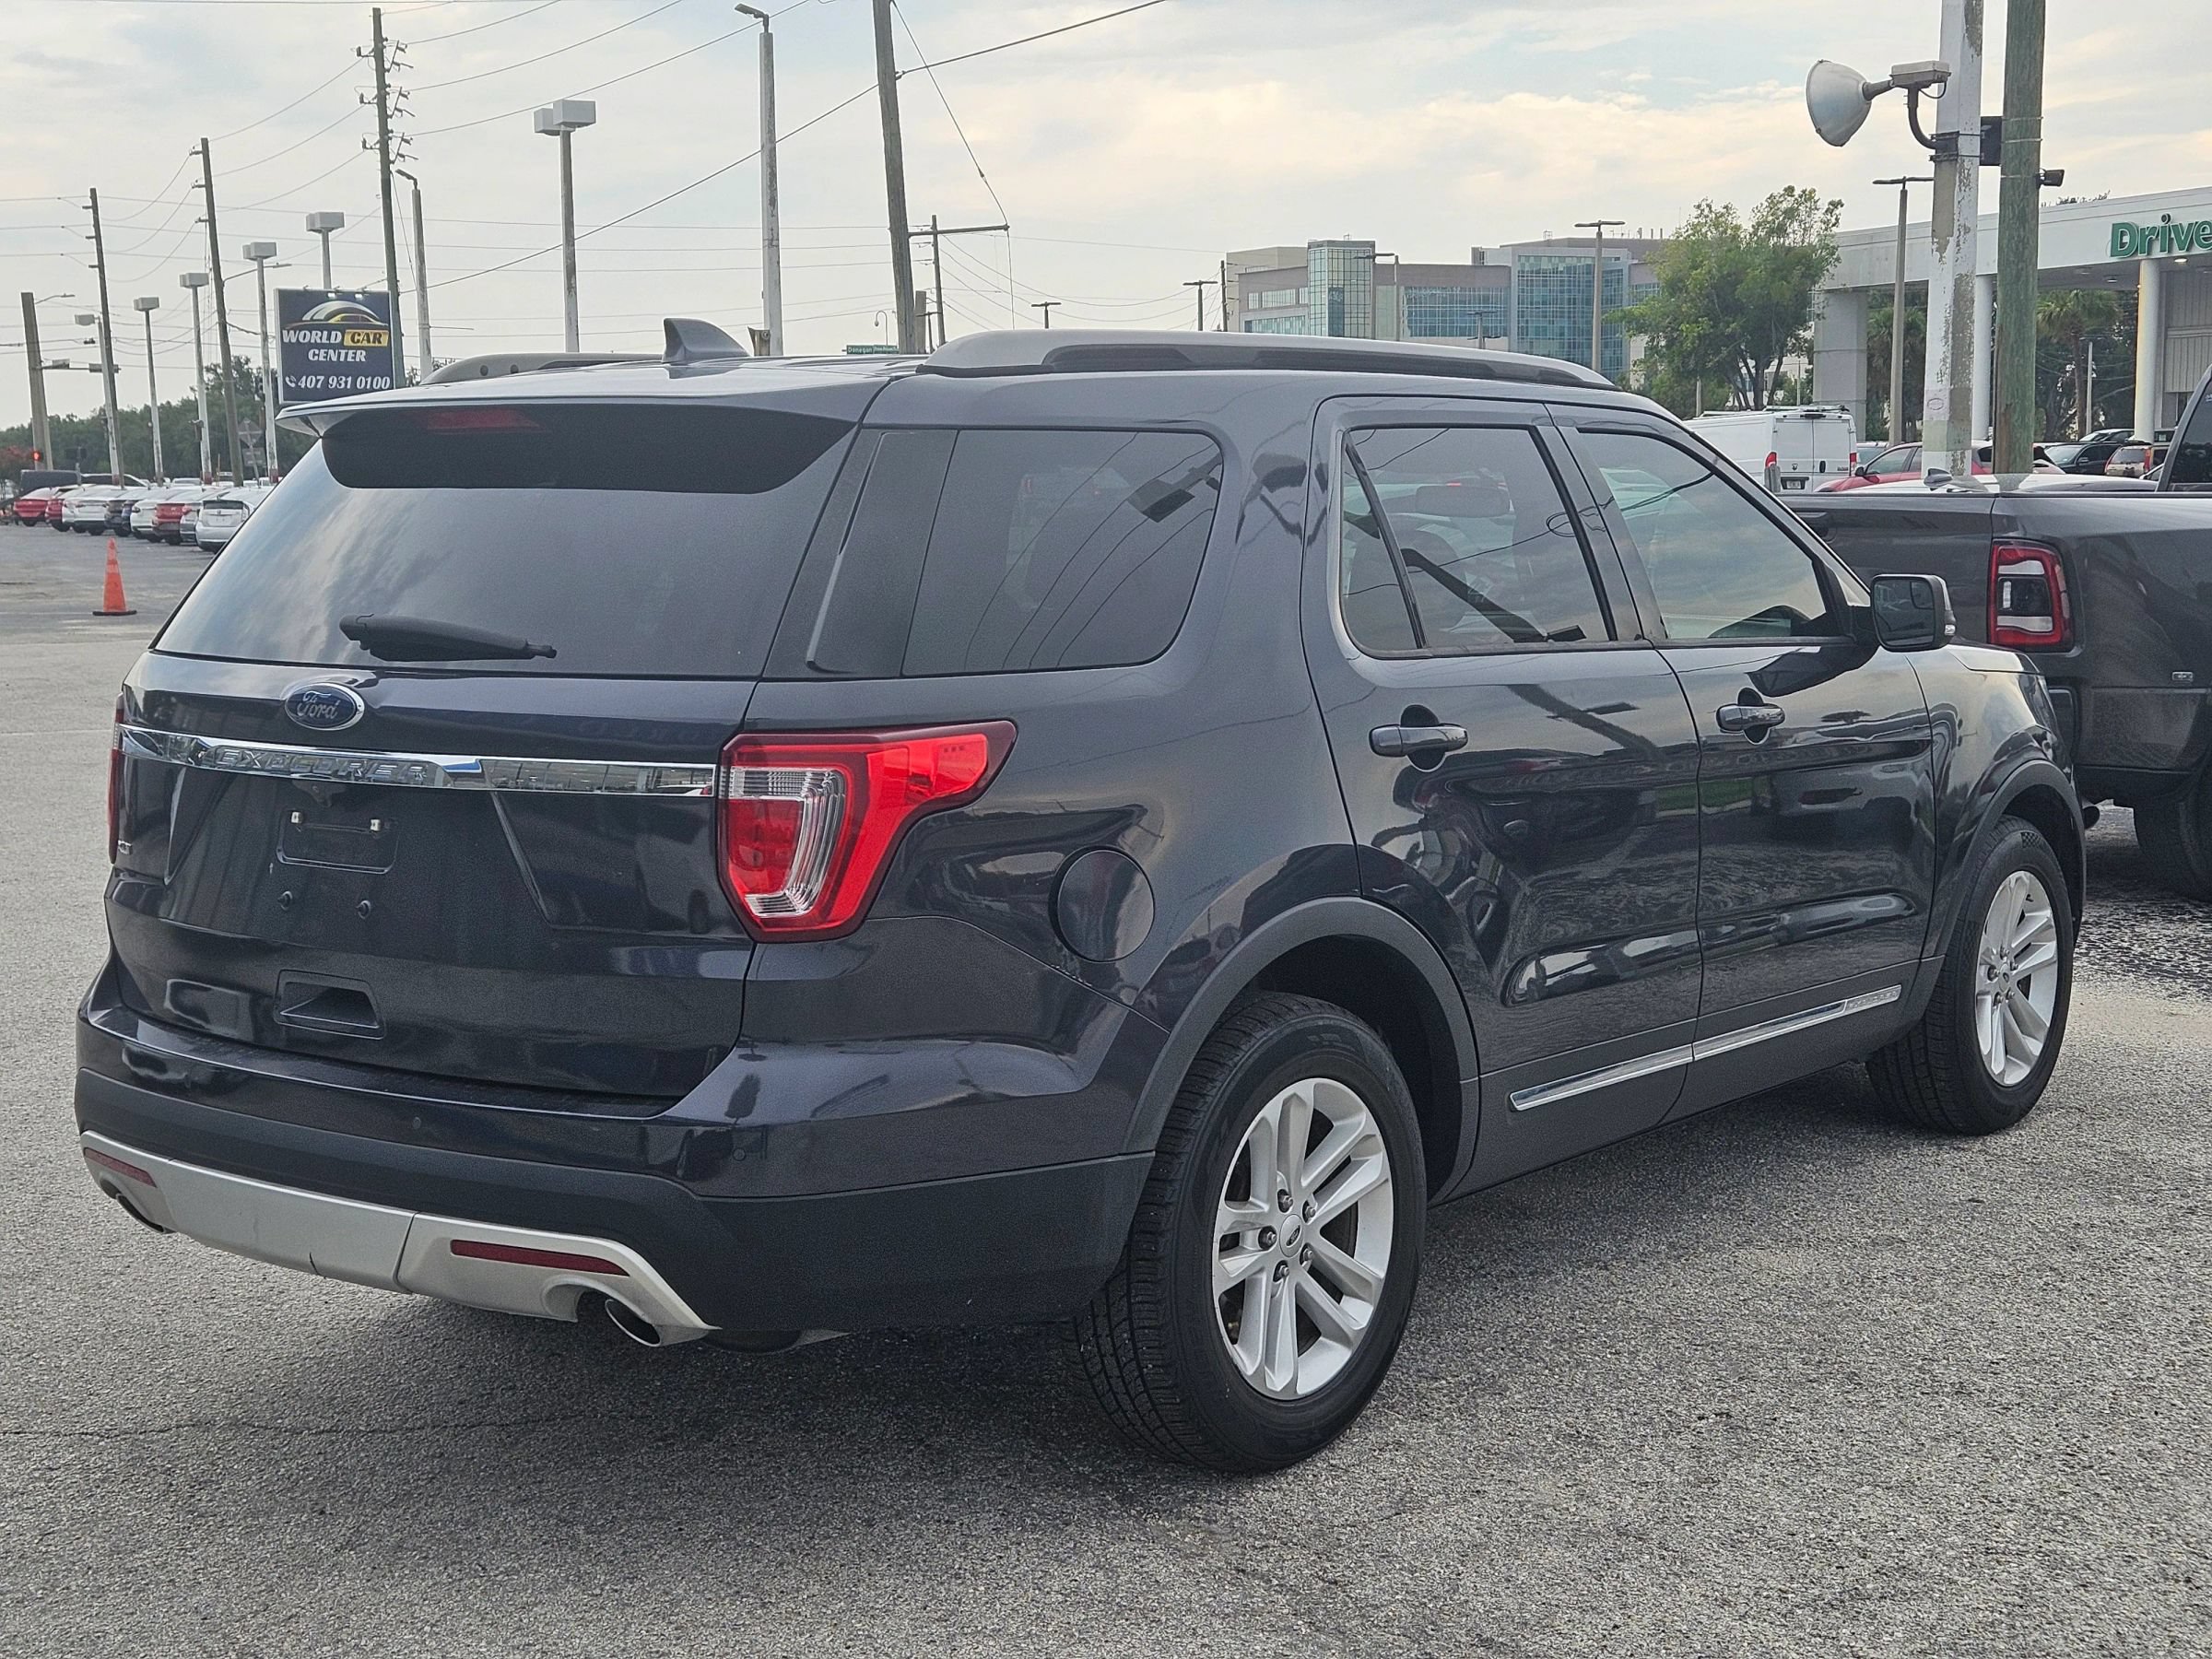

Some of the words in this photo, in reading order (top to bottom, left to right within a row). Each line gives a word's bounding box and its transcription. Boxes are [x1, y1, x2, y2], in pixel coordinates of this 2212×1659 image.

[2110, 213, 2212, 258] Drive
[282, 329, 342, 344] WORLD
[350, 331, 382, 345] CAR
[308, 348, 367, 362] CENTER
[298, 375, 324, 389] 407
[328, 375, 352, 389] 931
[356, 376, 391, 390] 0100
[297, 690, 341, 719] Ford
[216, 747, 428, 782] EXPLORER
